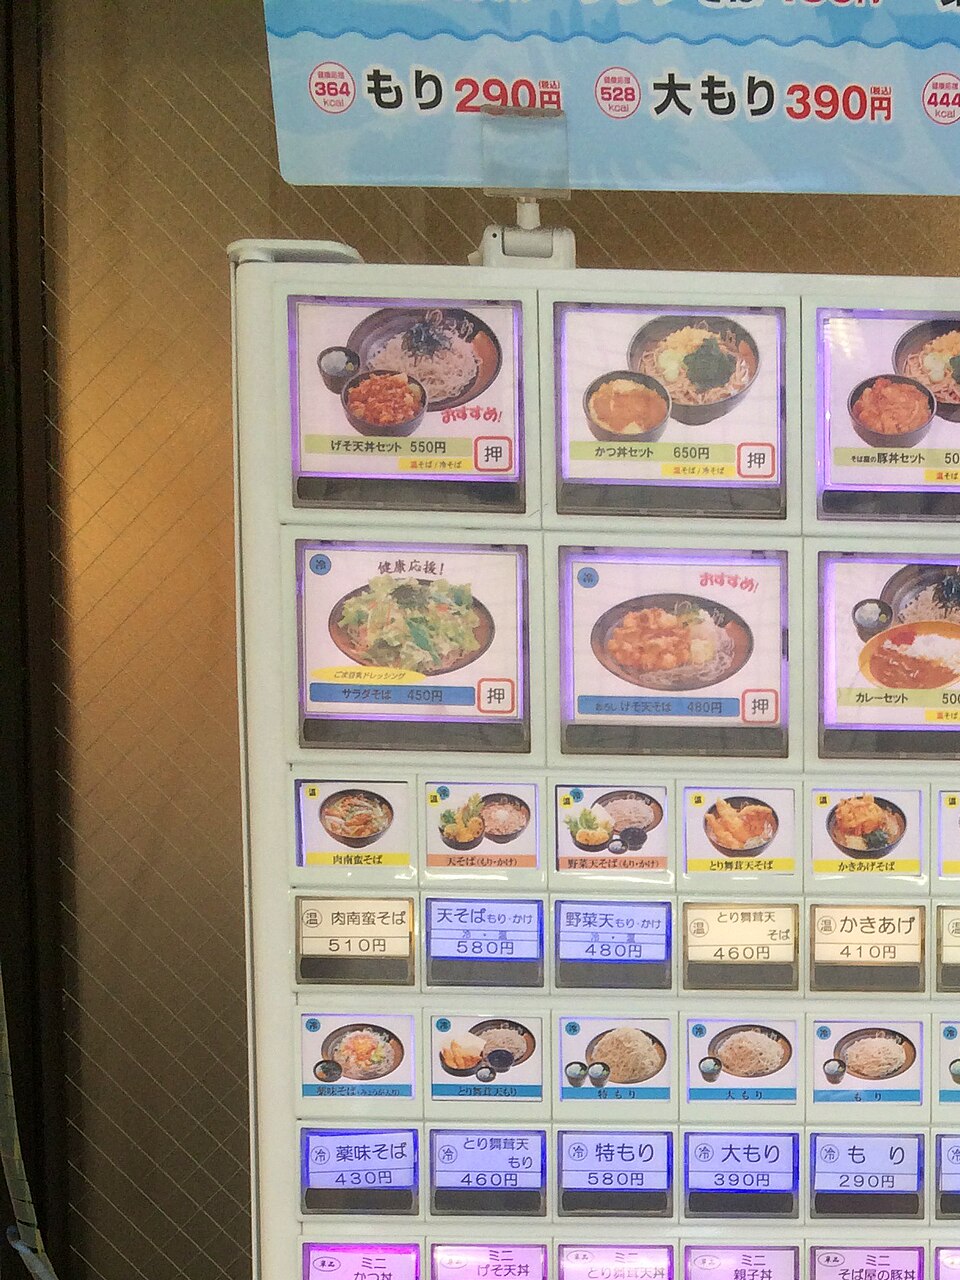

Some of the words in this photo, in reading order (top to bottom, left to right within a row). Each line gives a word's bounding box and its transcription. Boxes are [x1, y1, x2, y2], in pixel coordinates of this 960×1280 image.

[314, 81, 351, 98] 364
[367, 69, 443, 109] もり
[600, 85, 636, 102] 528
[653, 73, 773, 116] 大もり
[786, 84, 892, 121] 390円
[609, 103, 629, 112] kcal
[935, 109, 957, 118] kcal
[331, 440, 402, 453] げそ天丼セット
[410, 441, 447, 454] 550円
[595, 446, 654, 459] かつ丼セット
[673, 447, 710, 460] 650円
[484, 446, 502, 463] 押
[407, 688, 443, 702] 450円
[487, 688, 505, 704] 押
[855, 692, 908, 704] カレーセット
[333, 855, 382, 864] 肉南蛮そば
[839, 861, 895, 871] かきあげそば
[331, 911, 406, 925] 肉南蛮そば
[839, 916, 915, 933] かきあげ
[329, 939, 386, 952] 510円
[457, 941, 514, 954] 580円
[585, 944, 642, 958] 480円
[840, 945, 896, 958] 410円
[714, 947, 770, 959] 460円
[336, 1142, 407, 1161] 薬味そば
[596, 1143, 654, 1162] 特もり
[721, 1144, 780, 1163] 大もり
[336, 1172, 392, 1184] 430円
[461, 1173, 518, 1186] 460円
[588, 1173, 644, 1186] 580円
[714, 1174, 770, 1187] 390円
[839, 1175, 894, 1188] 290円
[362, 1258, 386, 1270] ミニ
[477, 1264, 529, 1277] げそ天丼
